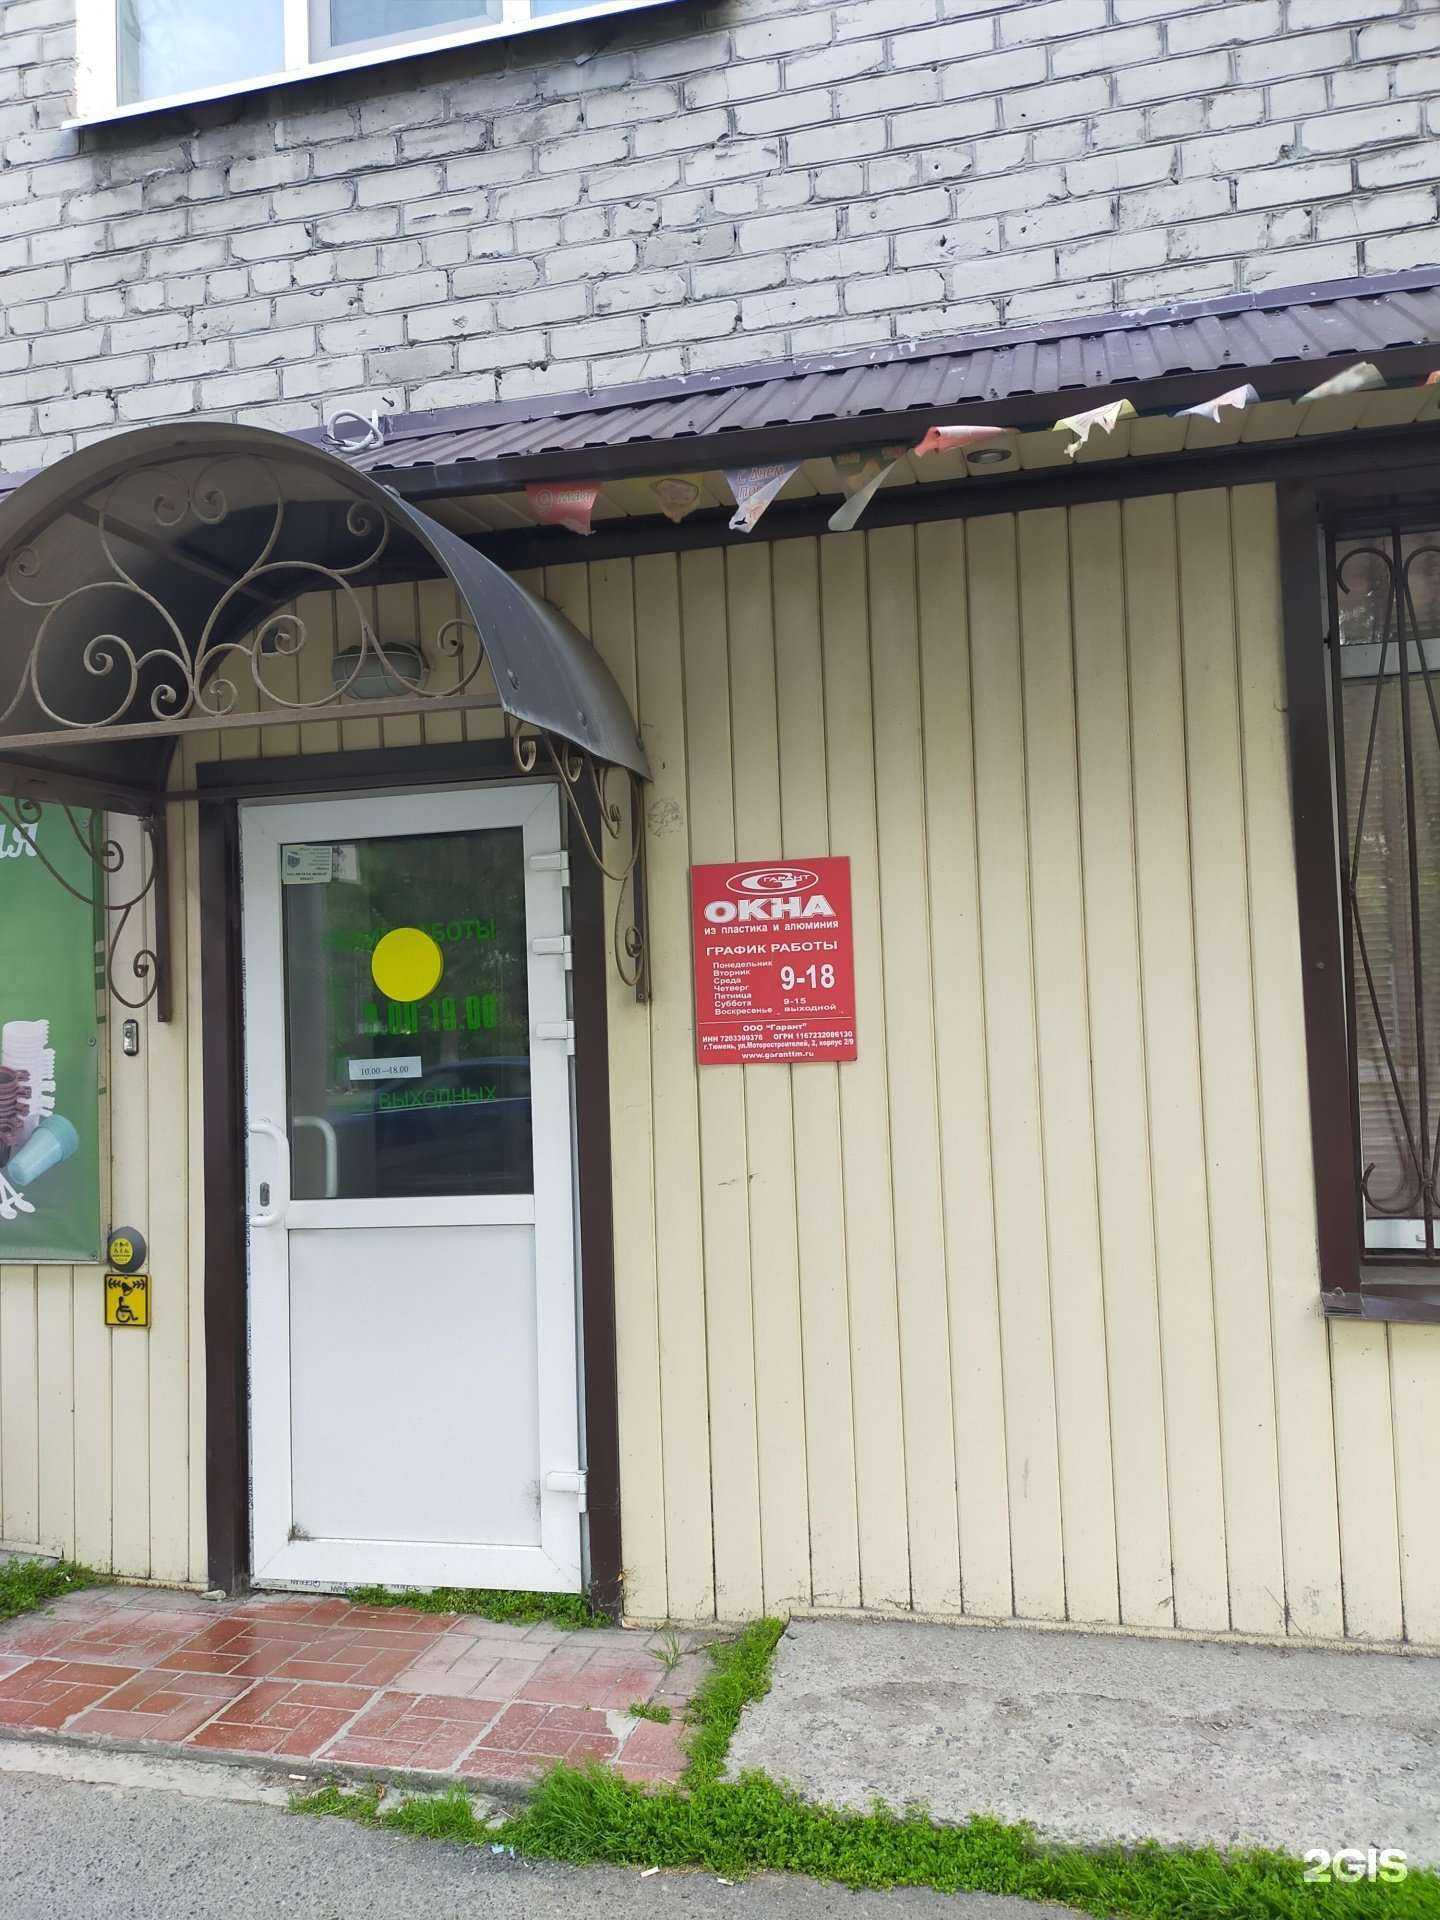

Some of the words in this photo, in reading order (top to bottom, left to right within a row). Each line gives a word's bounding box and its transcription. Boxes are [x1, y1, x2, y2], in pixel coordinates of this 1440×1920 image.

[704, 895, 837, 924] ОКНА
[704, 927, 717, 936] из
[721, 923, 768, 935] пластика
[773, 923, 780, 932] и
[784, 919, 839, 932] алюминия
[706, 944, 767, 957] ГРАФИК
[771, 940, 838, 953] РАБОТЫ
[713, 960, 773, 969] Понедельник
[713, 969, 751, 977] Вторник
[780, 963, 836, 991] 9-18
[713, 977, 742, 985] Среда
[714, 984, 750, 992] Четверг
[714, 992, 752, 1000] Пятница
[714, 1000, 752, 1008] Суббота
[715, 1007, 773, 1016] Воскресенье
[784, 1004, 837, 1012] выходной
[742, 1024, 763, 1032] ООО
[773, 1032, 794, 1040] ОГРН
